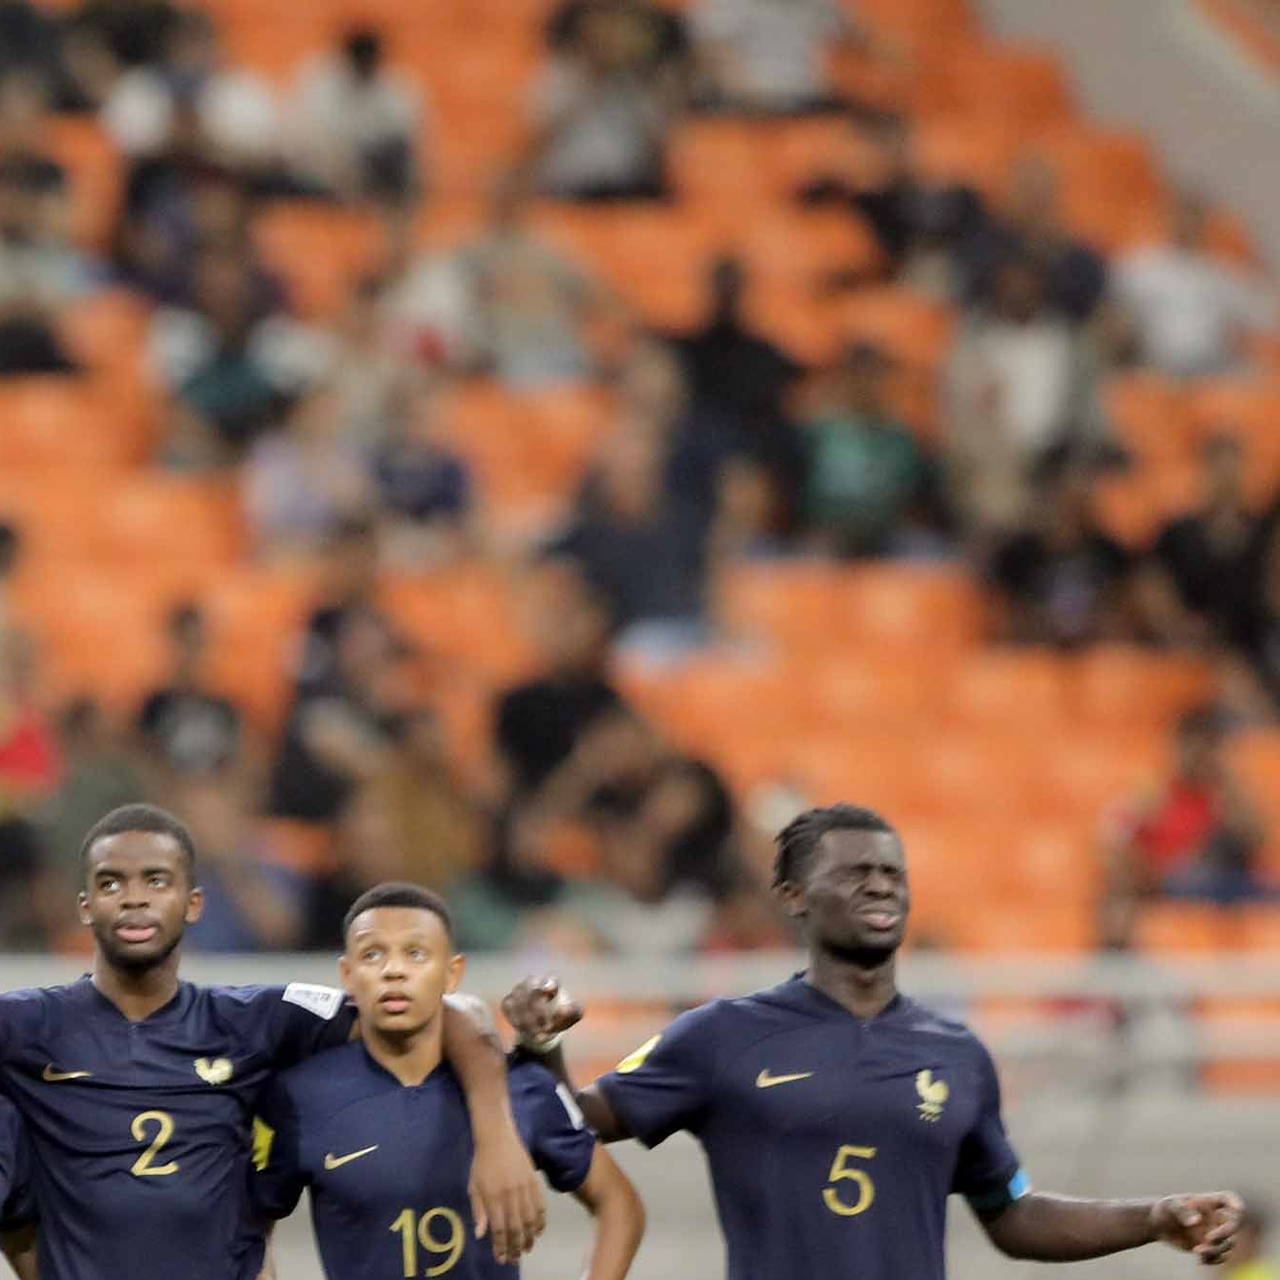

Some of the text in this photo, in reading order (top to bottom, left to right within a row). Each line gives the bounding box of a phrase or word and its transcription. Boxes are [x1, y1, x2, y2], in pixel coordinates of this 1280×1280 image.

[131, 1110, 179, 1176] 2
[823, 1145, 875, 1216] 5
[390, 1208, 465, 1277] 19
